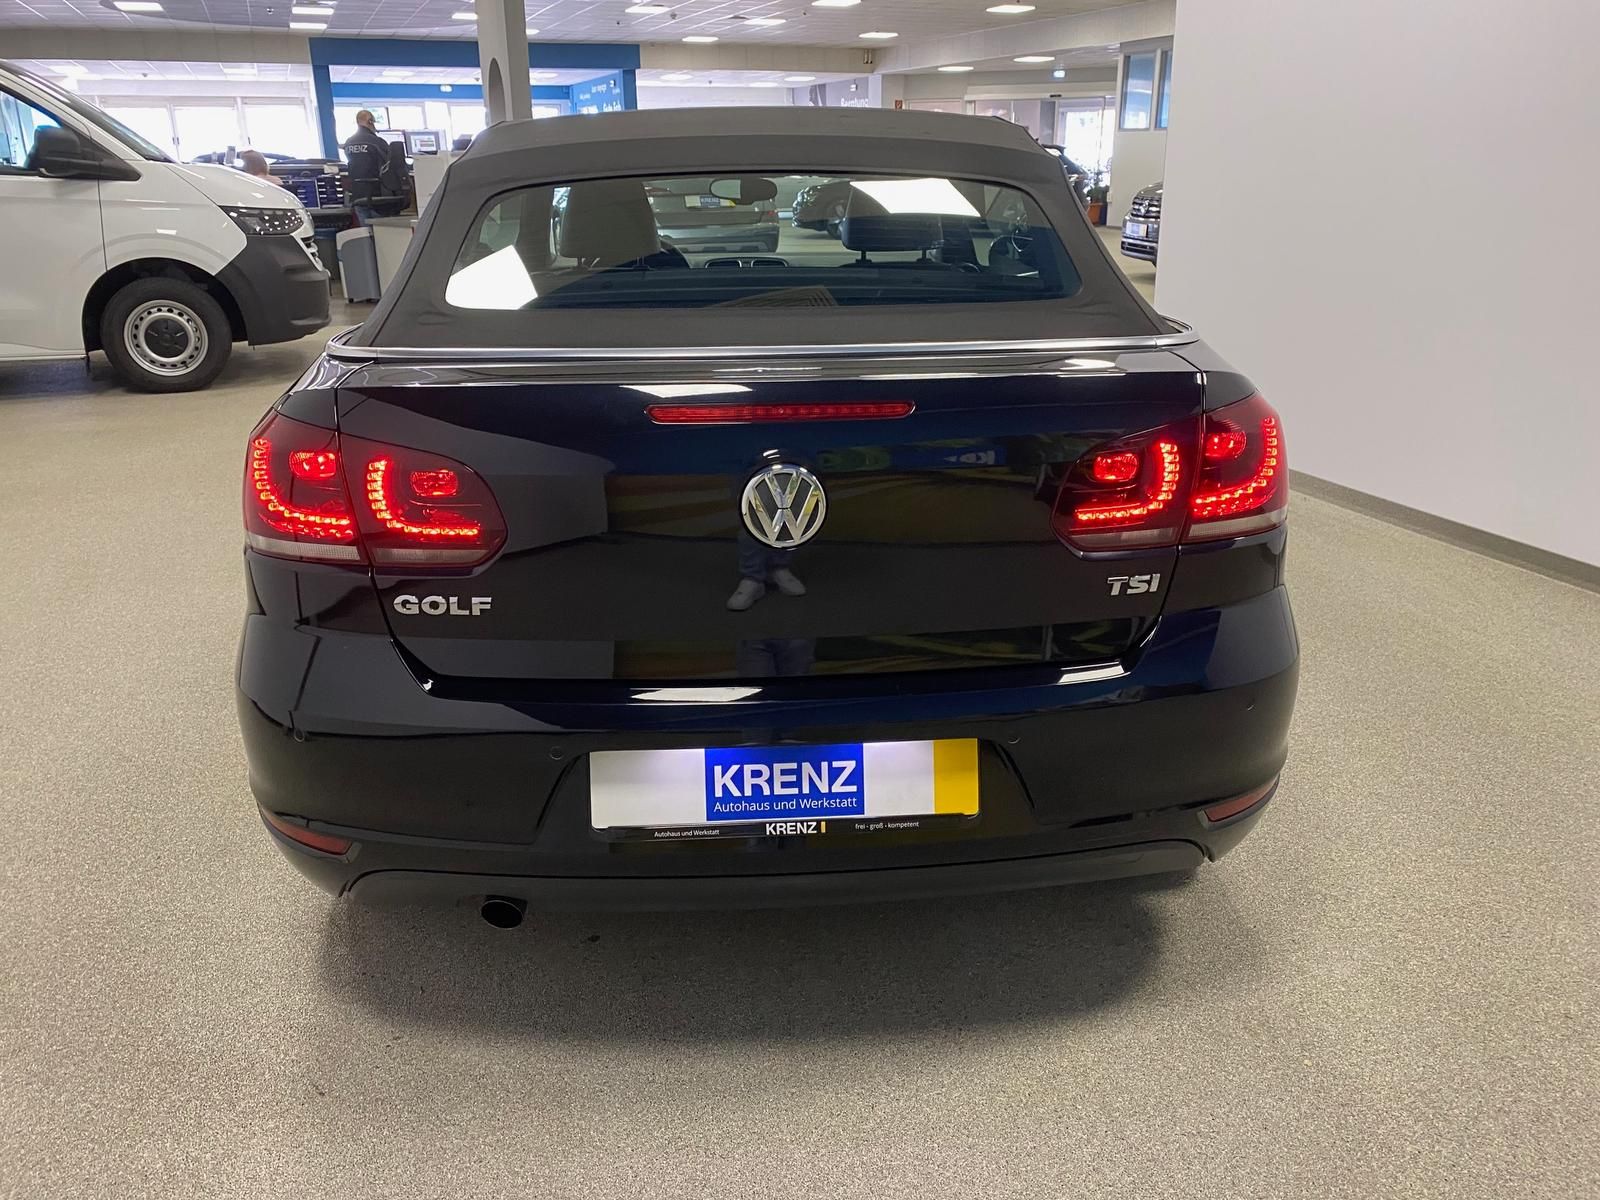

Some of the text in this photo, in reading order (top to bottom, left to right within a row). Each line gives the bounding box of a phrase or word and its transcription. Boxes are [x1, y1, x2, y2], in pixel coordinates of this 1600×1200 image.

[1107, 573, 1161, 596] TSI
[393, 594, 492, 616] GOLF
[713, 760, 858, 798] KRENZ
[713, 797, 857, 813] Autohaus und Werkstatt
[765, 821, 818, 836] KRENZ
[869, 822, 884, 831] groß
[887, 821, 920, 830] kompetent
